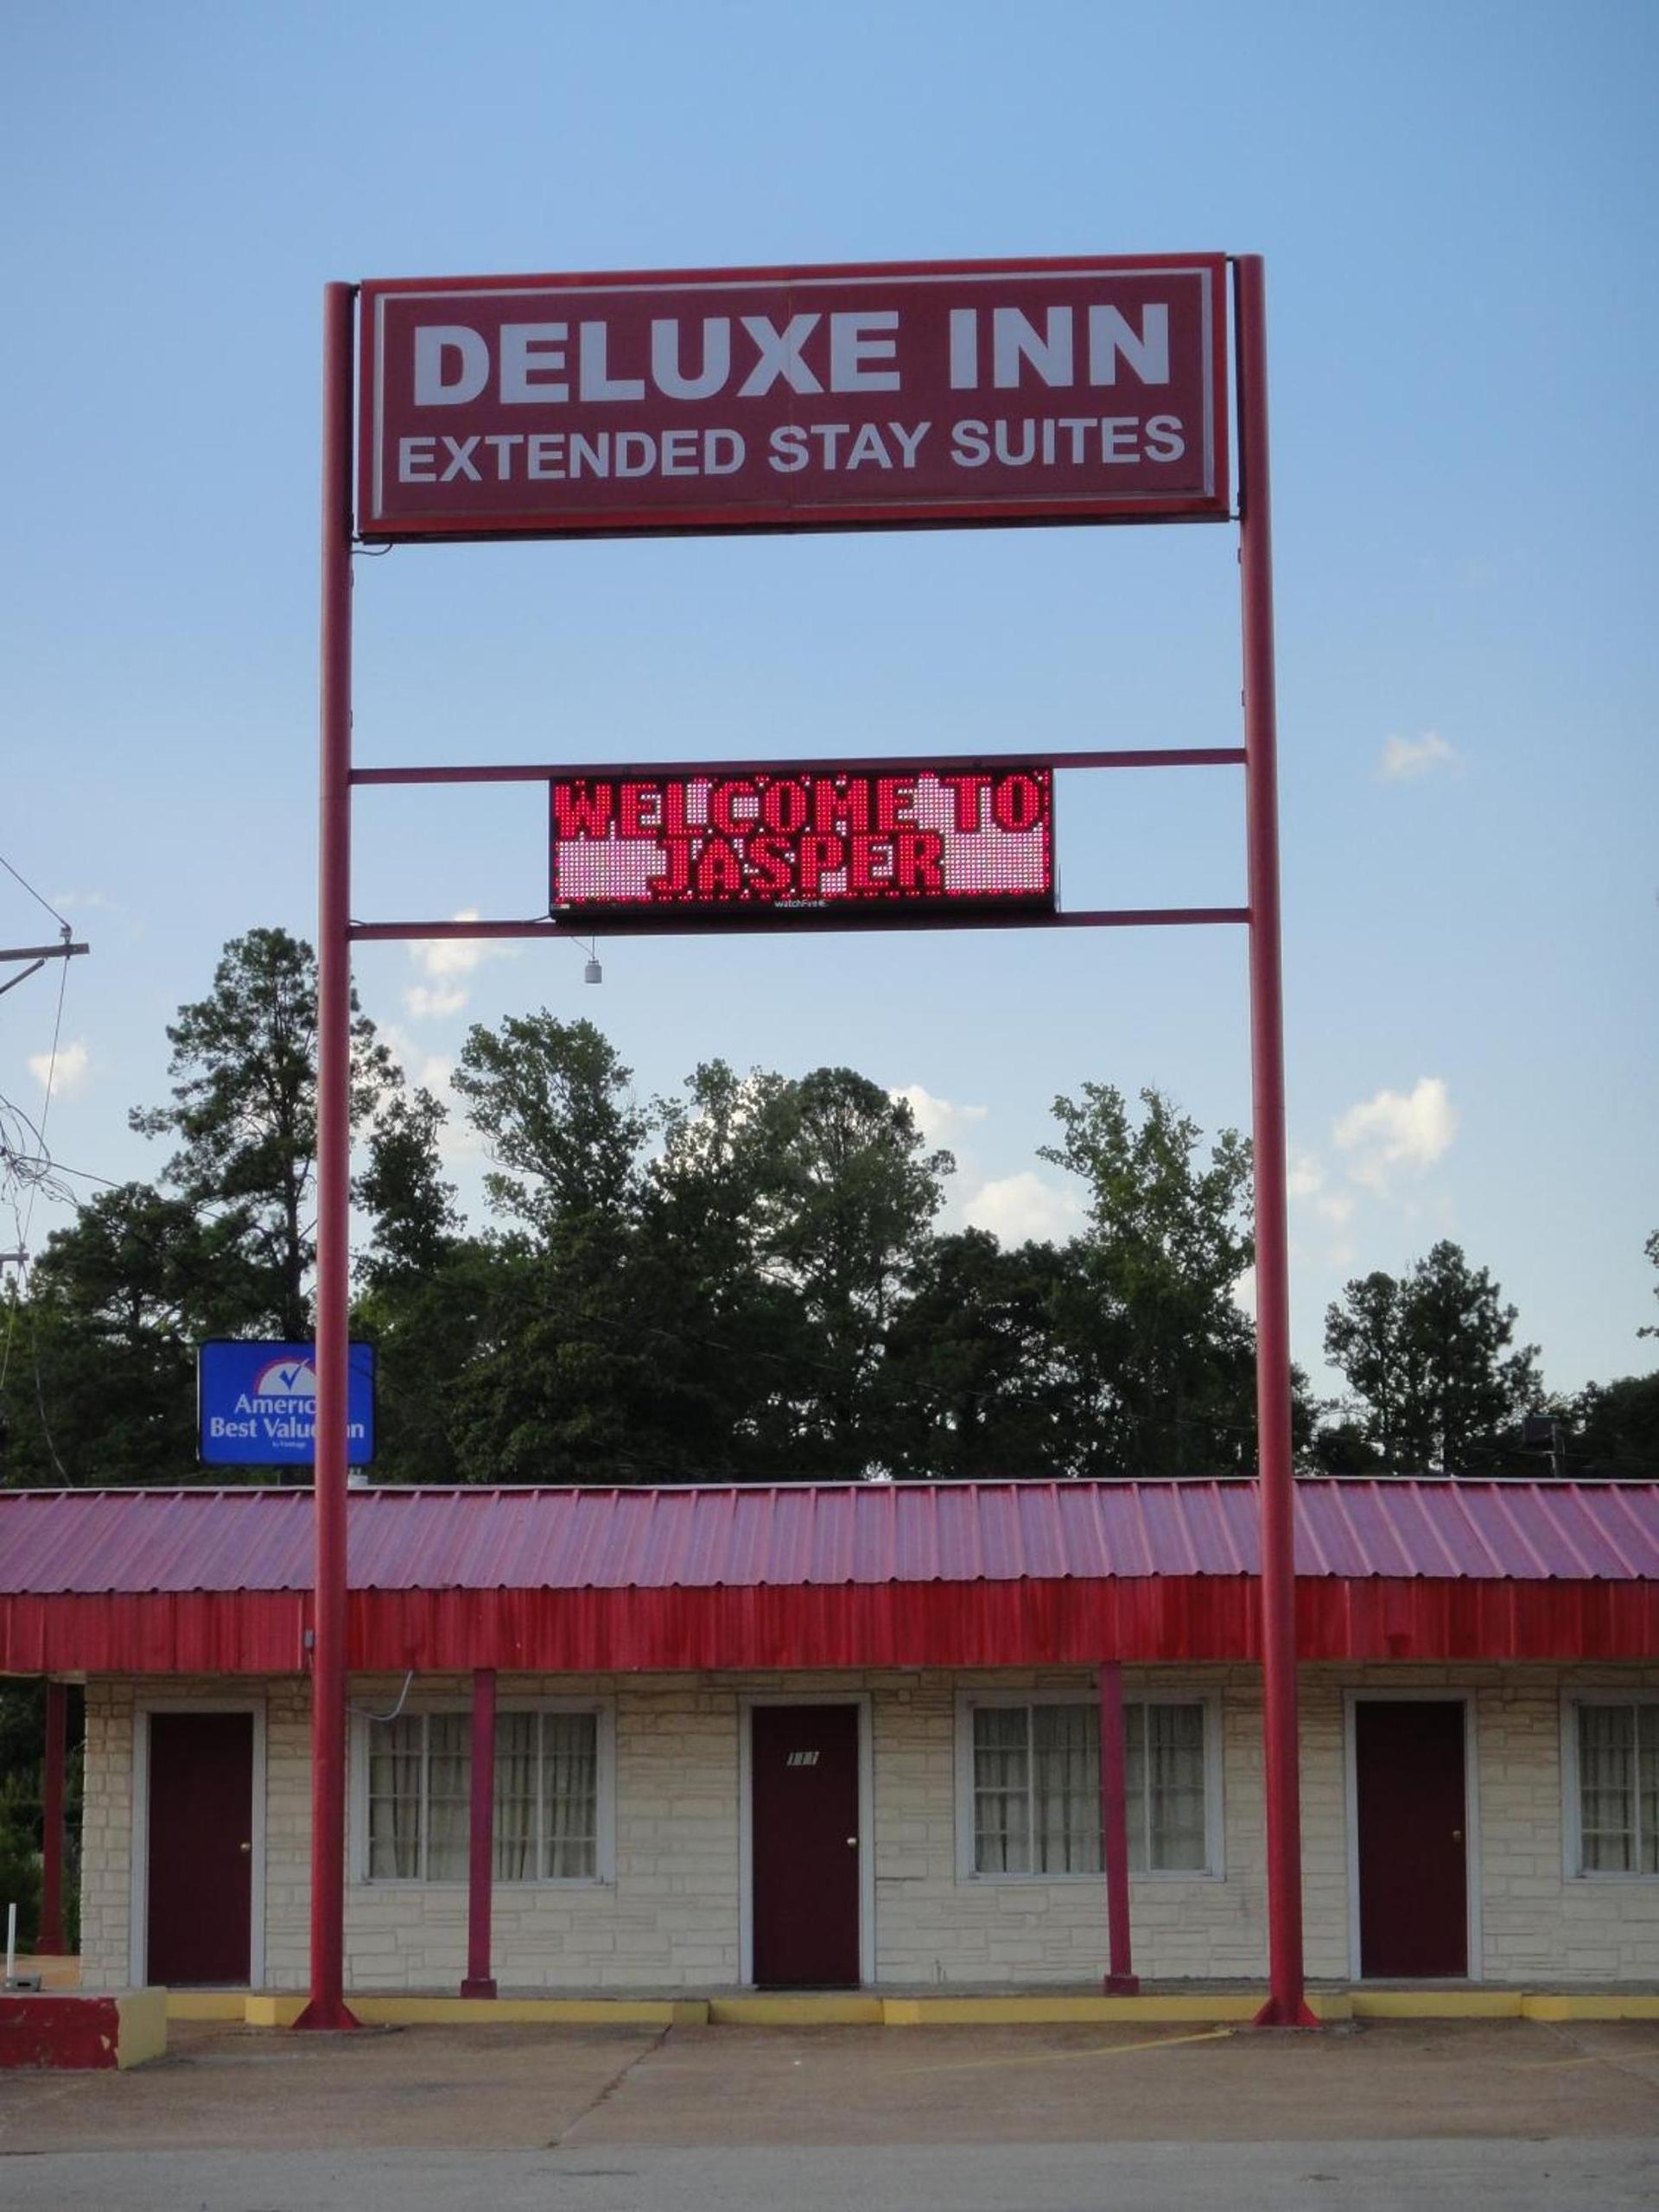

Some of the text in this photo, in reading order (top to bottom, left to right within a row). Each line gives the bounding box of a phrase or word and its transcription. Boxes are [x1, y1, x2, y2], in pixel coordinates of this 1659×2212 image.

[413, 303, 1170, 406] DELUXE INN
[397, 415, 1185, 483] EXTENDED STAY SUITES
[554, 775, 1039, 837] WELCOME TO
[652, 833, 942, 890] JASPER
[210, 1417, 257, 1438] Best
[234, 1393, 317, 1414] Americ
